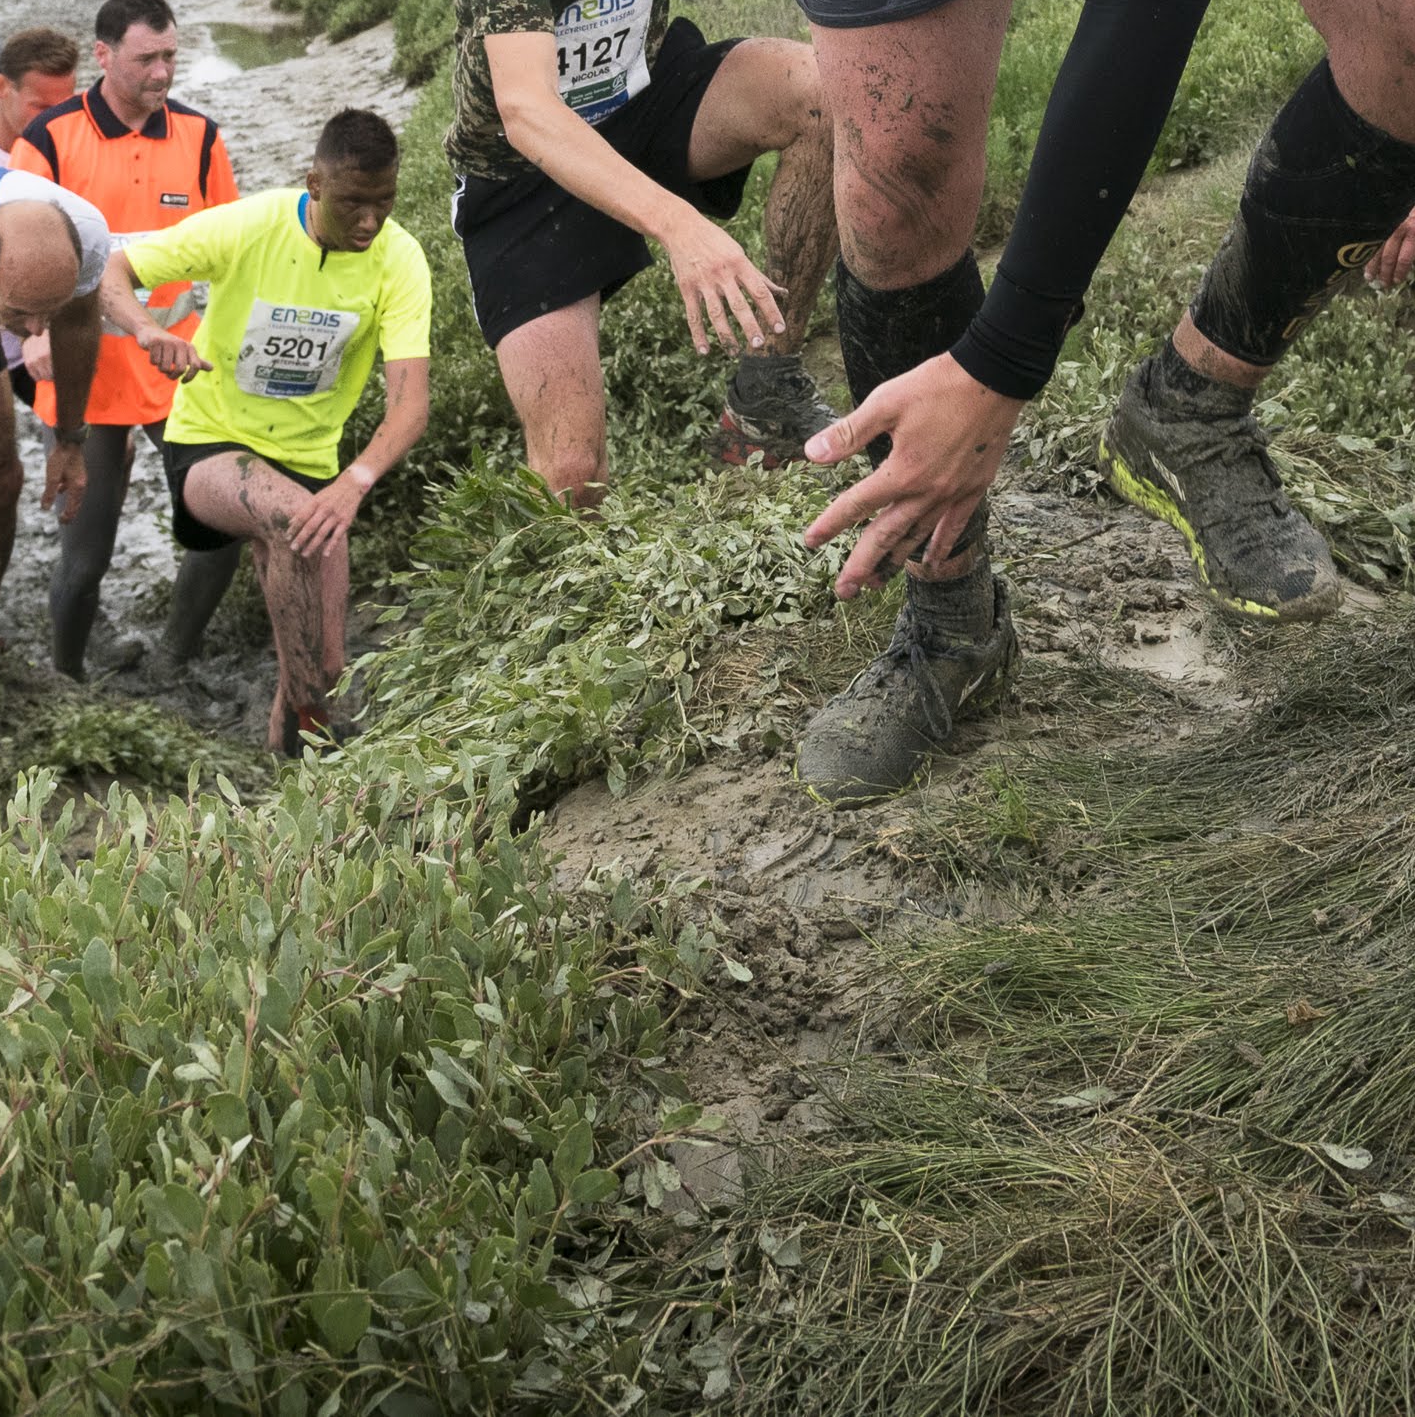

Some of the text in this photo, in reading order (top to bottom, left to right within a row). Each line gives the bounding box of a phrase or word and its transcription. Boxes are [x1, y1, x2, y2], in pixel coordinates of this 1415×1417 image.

[556, 27, 631, 77] 4127
[571, 66, 610, 85] NICOLAS
[263, 335, 328, 361] 5201
